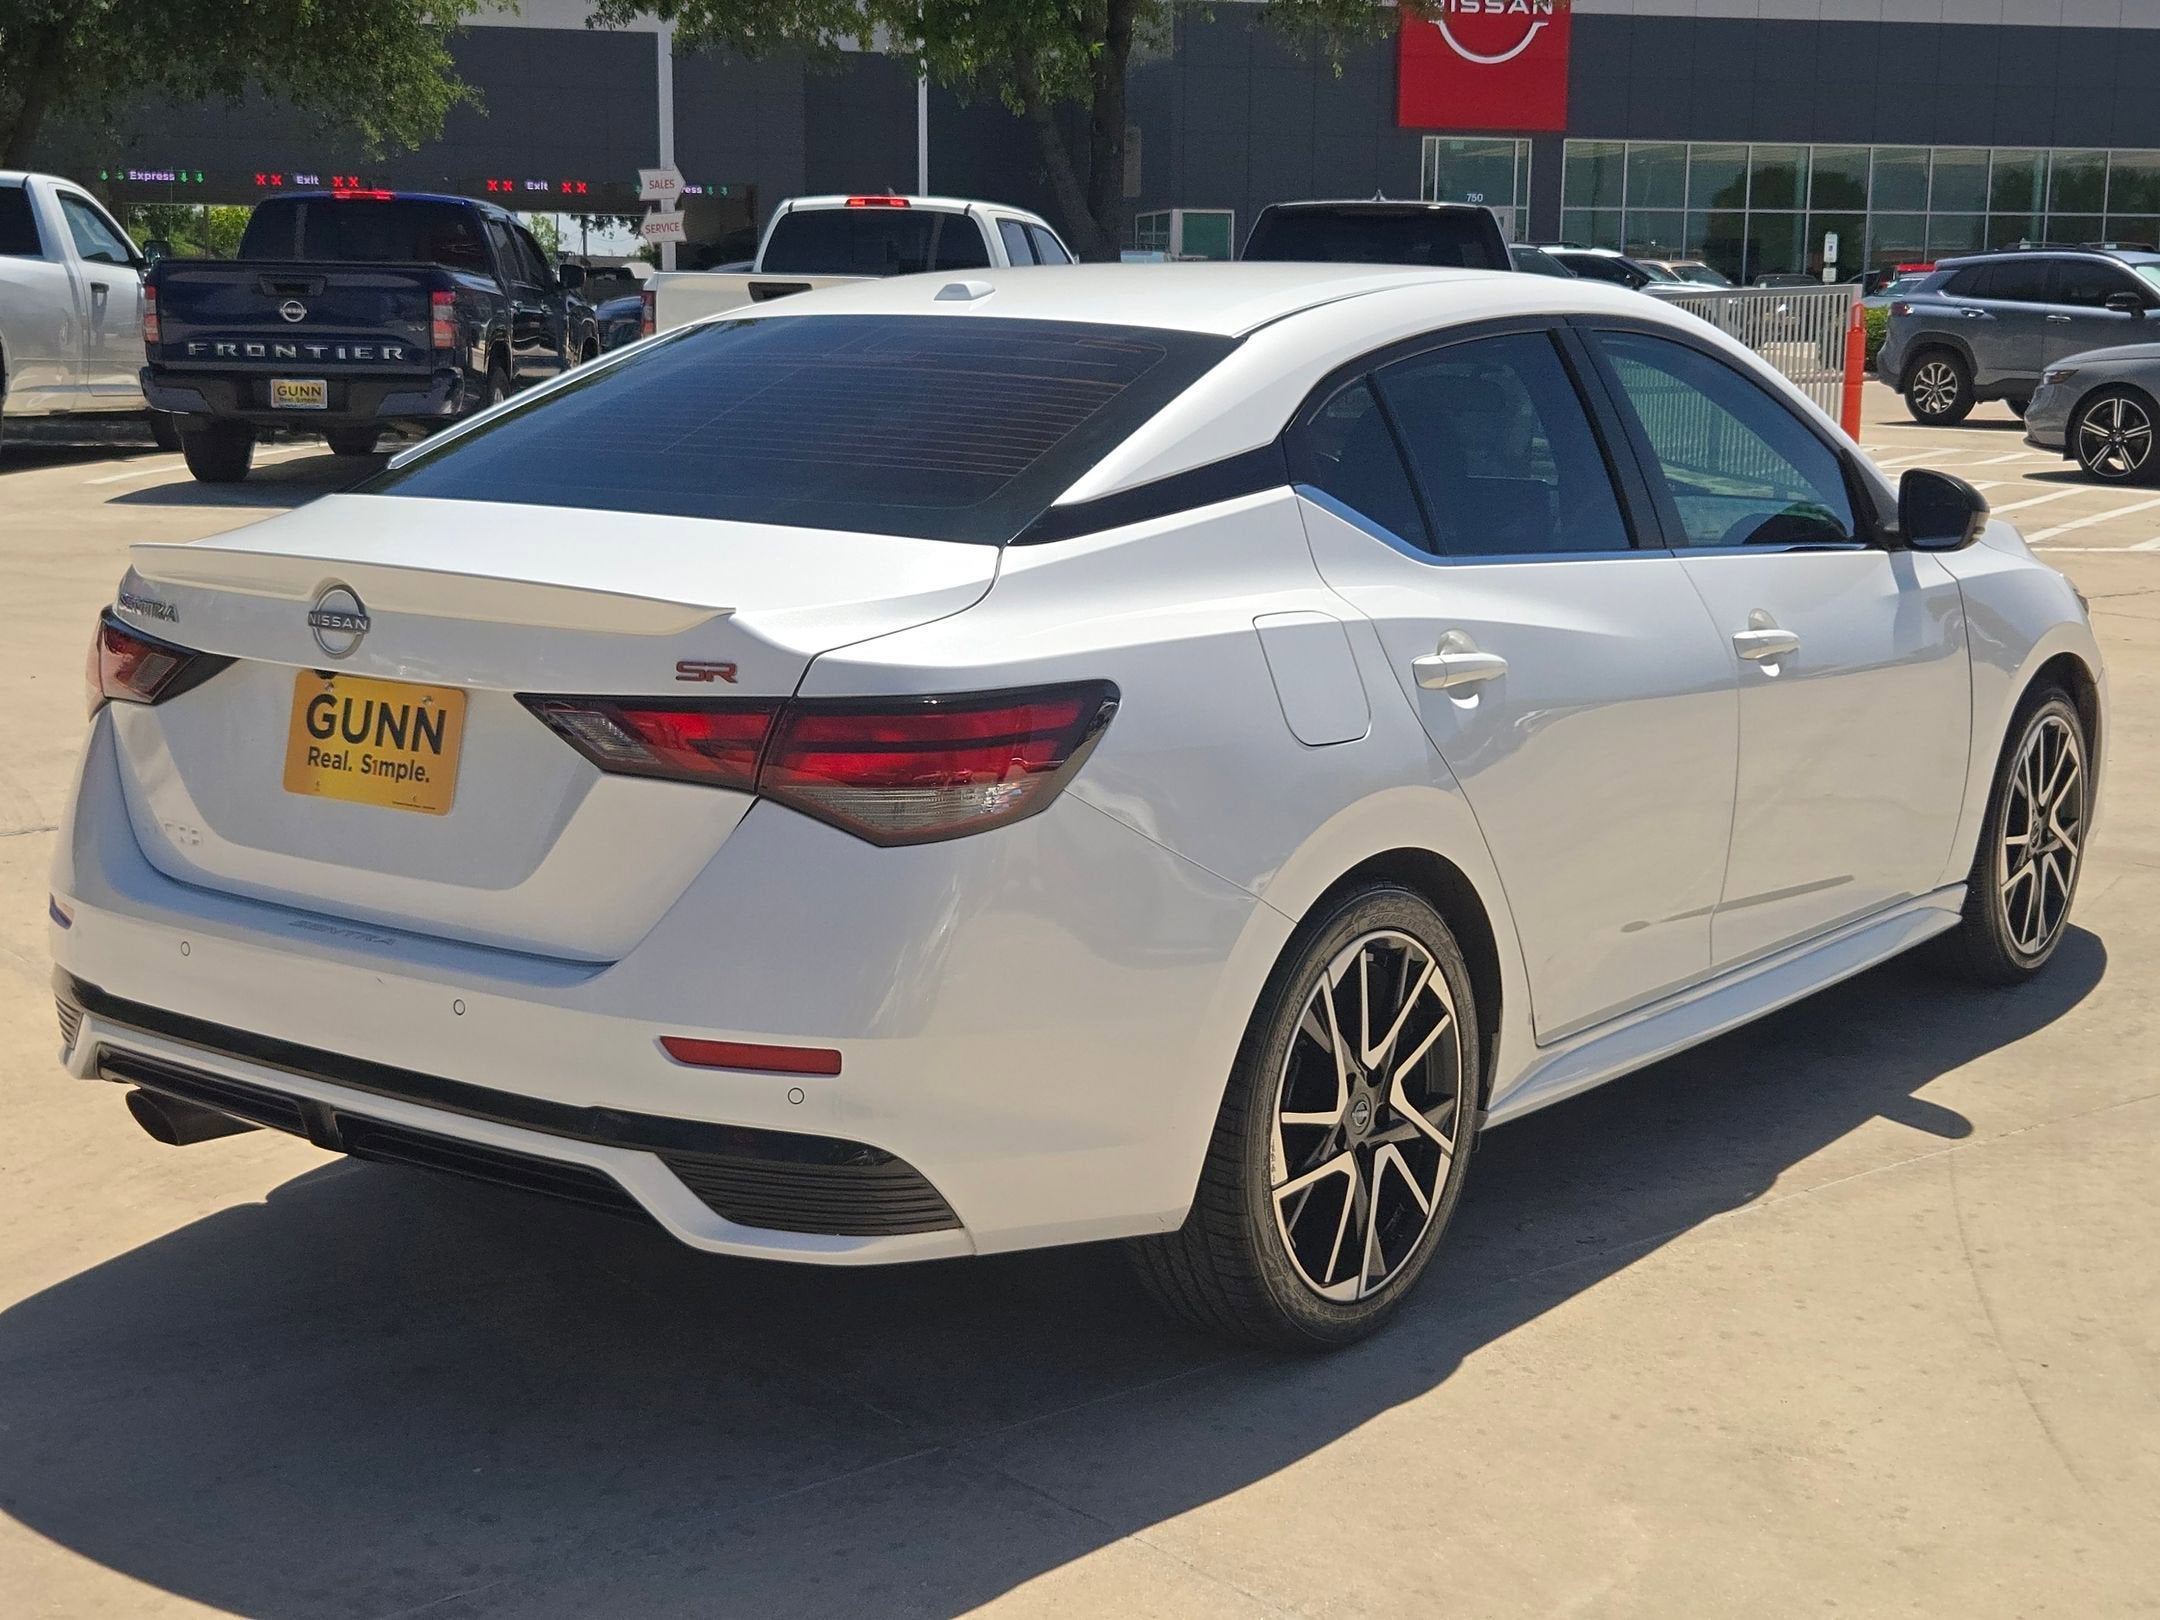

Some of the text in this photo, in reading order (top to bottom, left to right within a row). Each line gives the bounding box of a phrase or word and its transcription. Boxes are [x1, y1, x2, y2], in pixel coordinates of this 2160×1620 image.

[1437, 0, 1553, 14] ISSAN
[129, 171, 175, 182] Express
[296, 175, 320, 185] Exit
[526, 181, 549, 191] Exit
[649, 179, 675, 190] SALES
[1466, 193, 1484, 202] 750
[645, 223, 681, 234] SERVICE
[187, 342, 404, 360] FRONTIER
[277, 385, 322, 397] GUNN
[309, 612, 368, 630] NISSAN
[675, 660, 739, 683] SR
[306, 693, 447, 755] GUNN
[307, 746, 353, 772] Real.
